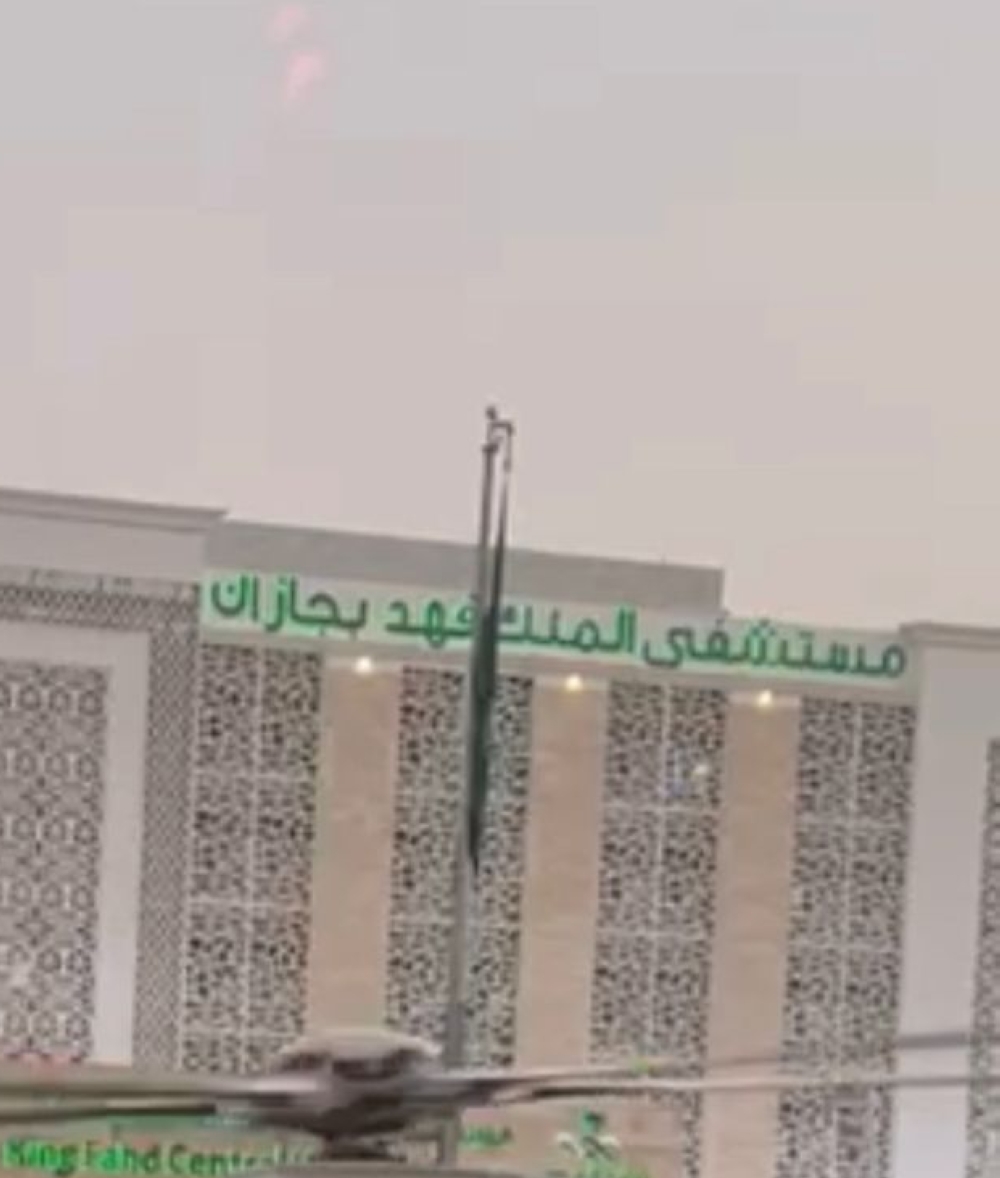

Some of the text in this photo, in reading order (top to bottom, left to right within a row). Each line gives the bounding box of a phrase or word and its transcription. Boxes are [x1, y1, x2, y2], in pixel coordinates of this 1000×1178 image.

[209, 574, 369, 641] بجازان
[643, 619, 907, 678] مستشفى
[2, 1136, 78, 1178] King
[85, 1139, 162, 1175] Fahd
